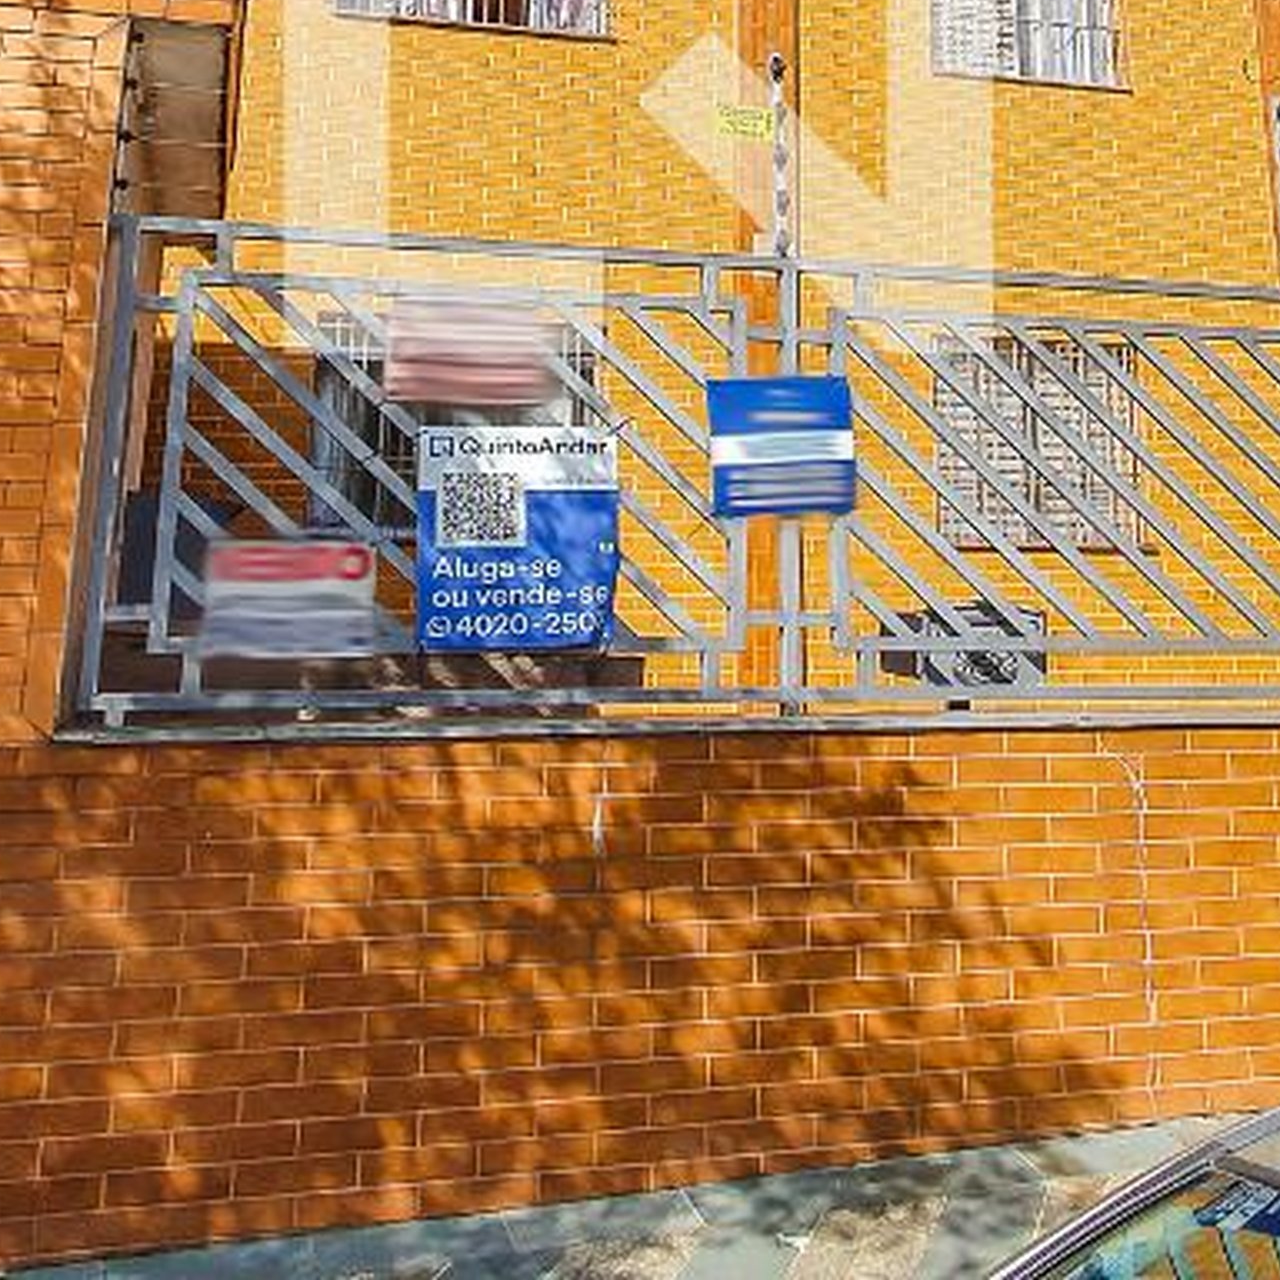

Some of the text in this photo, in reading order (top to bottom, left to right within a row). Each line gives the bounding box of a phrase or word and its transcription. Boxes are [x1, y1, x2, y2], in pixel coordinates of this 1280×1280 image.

[432, 556, 562, 584] Aluga-se
[432, 583, 610, 608] ou vende-se
[456, 611, 608, 638] 4020-250
